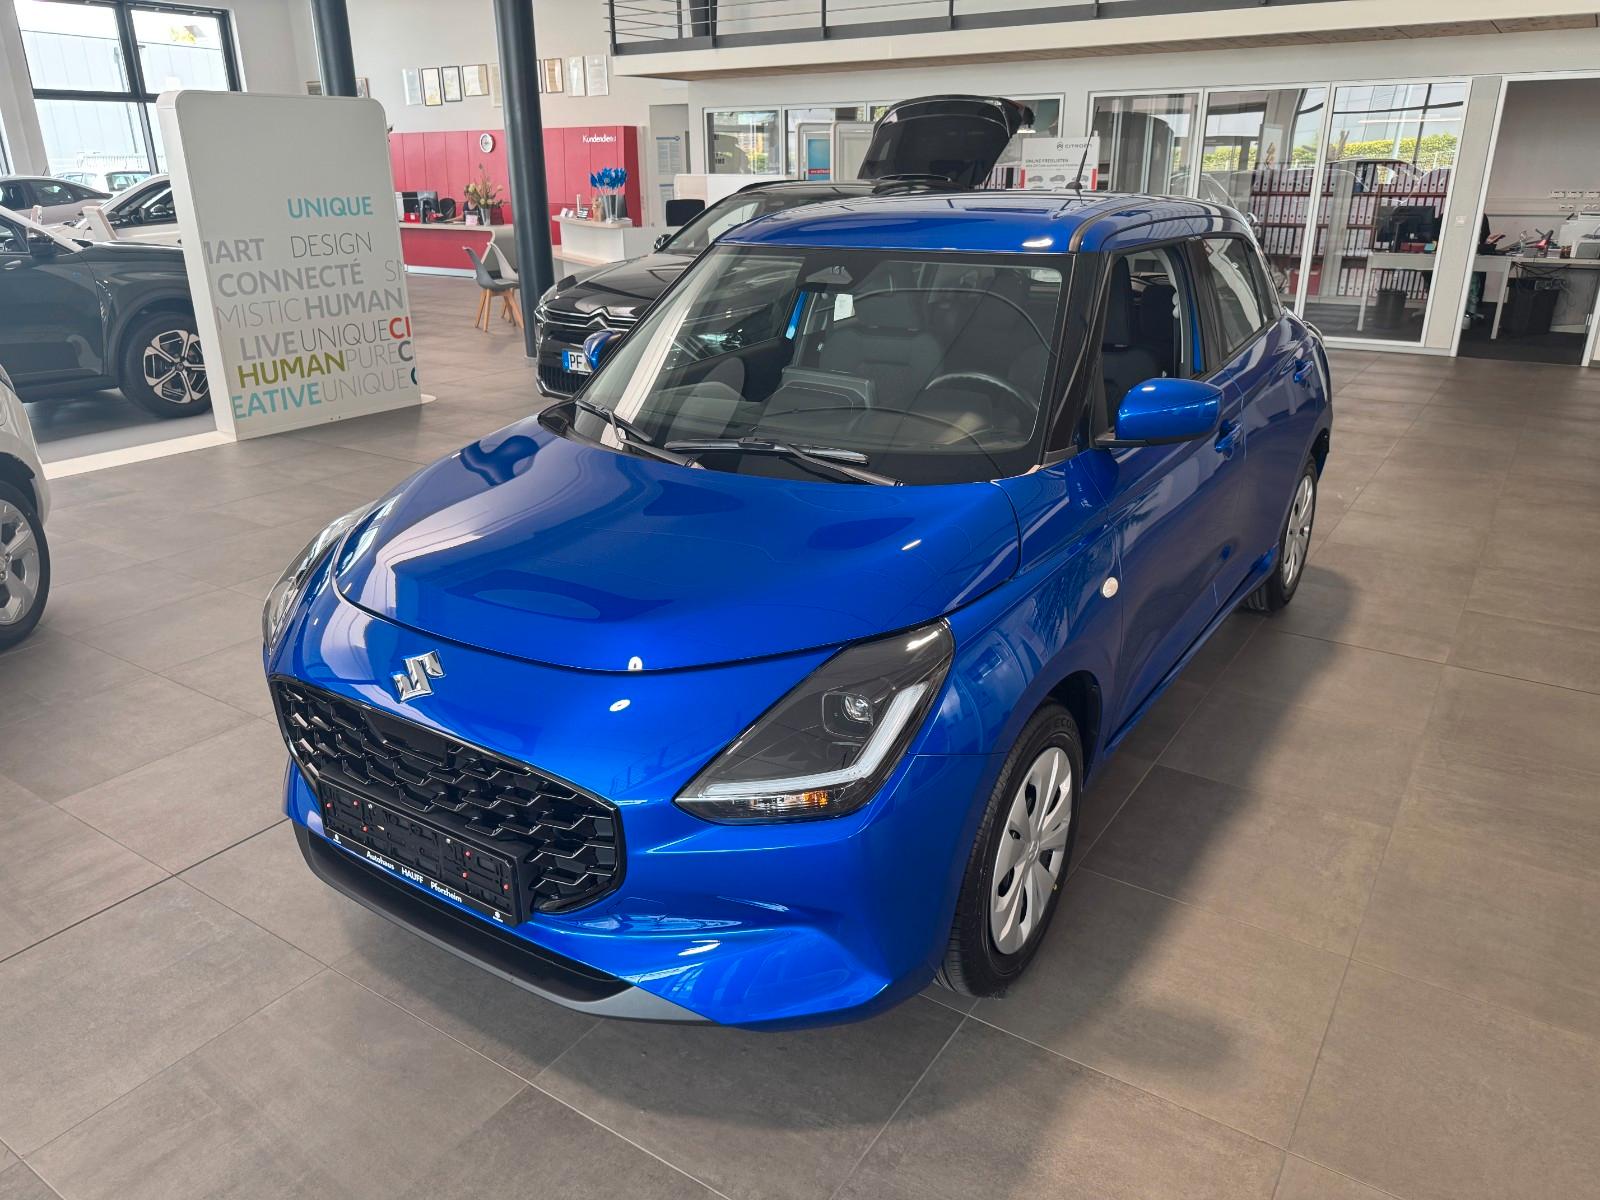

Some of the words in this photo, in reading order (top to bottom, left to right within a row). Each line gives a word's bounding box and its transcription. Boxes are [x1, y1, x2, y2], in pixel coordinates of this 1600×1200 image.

[287, 196, 374, 219] UNIQUE
[203, 238, 265, 265] ART
[290, 231, 373, 259] DESIGN
[217, 258, 364, 298] CONNECTÉ
[215, 298, 302, 330] MISTIC
[304, 287, 404, 321] HUMAN
[240, 331, 300, 361] LIVE
[300, 318, 390, 352] UNIQUE
[389, 316, 412, 340] CI
[237, 350, 346, 389] HUMAN
[345, 342, 400, 372] PURE
[398, 340, 414, 362] C
[569, 353, 583, 369] PF
[322, 367, 411, 403] UNIQUE
[366, 850, 395, 870] Autohaus
[401, 866, 424, 884] HAUFF
[430, 880, 463, 903] Pforzheim
